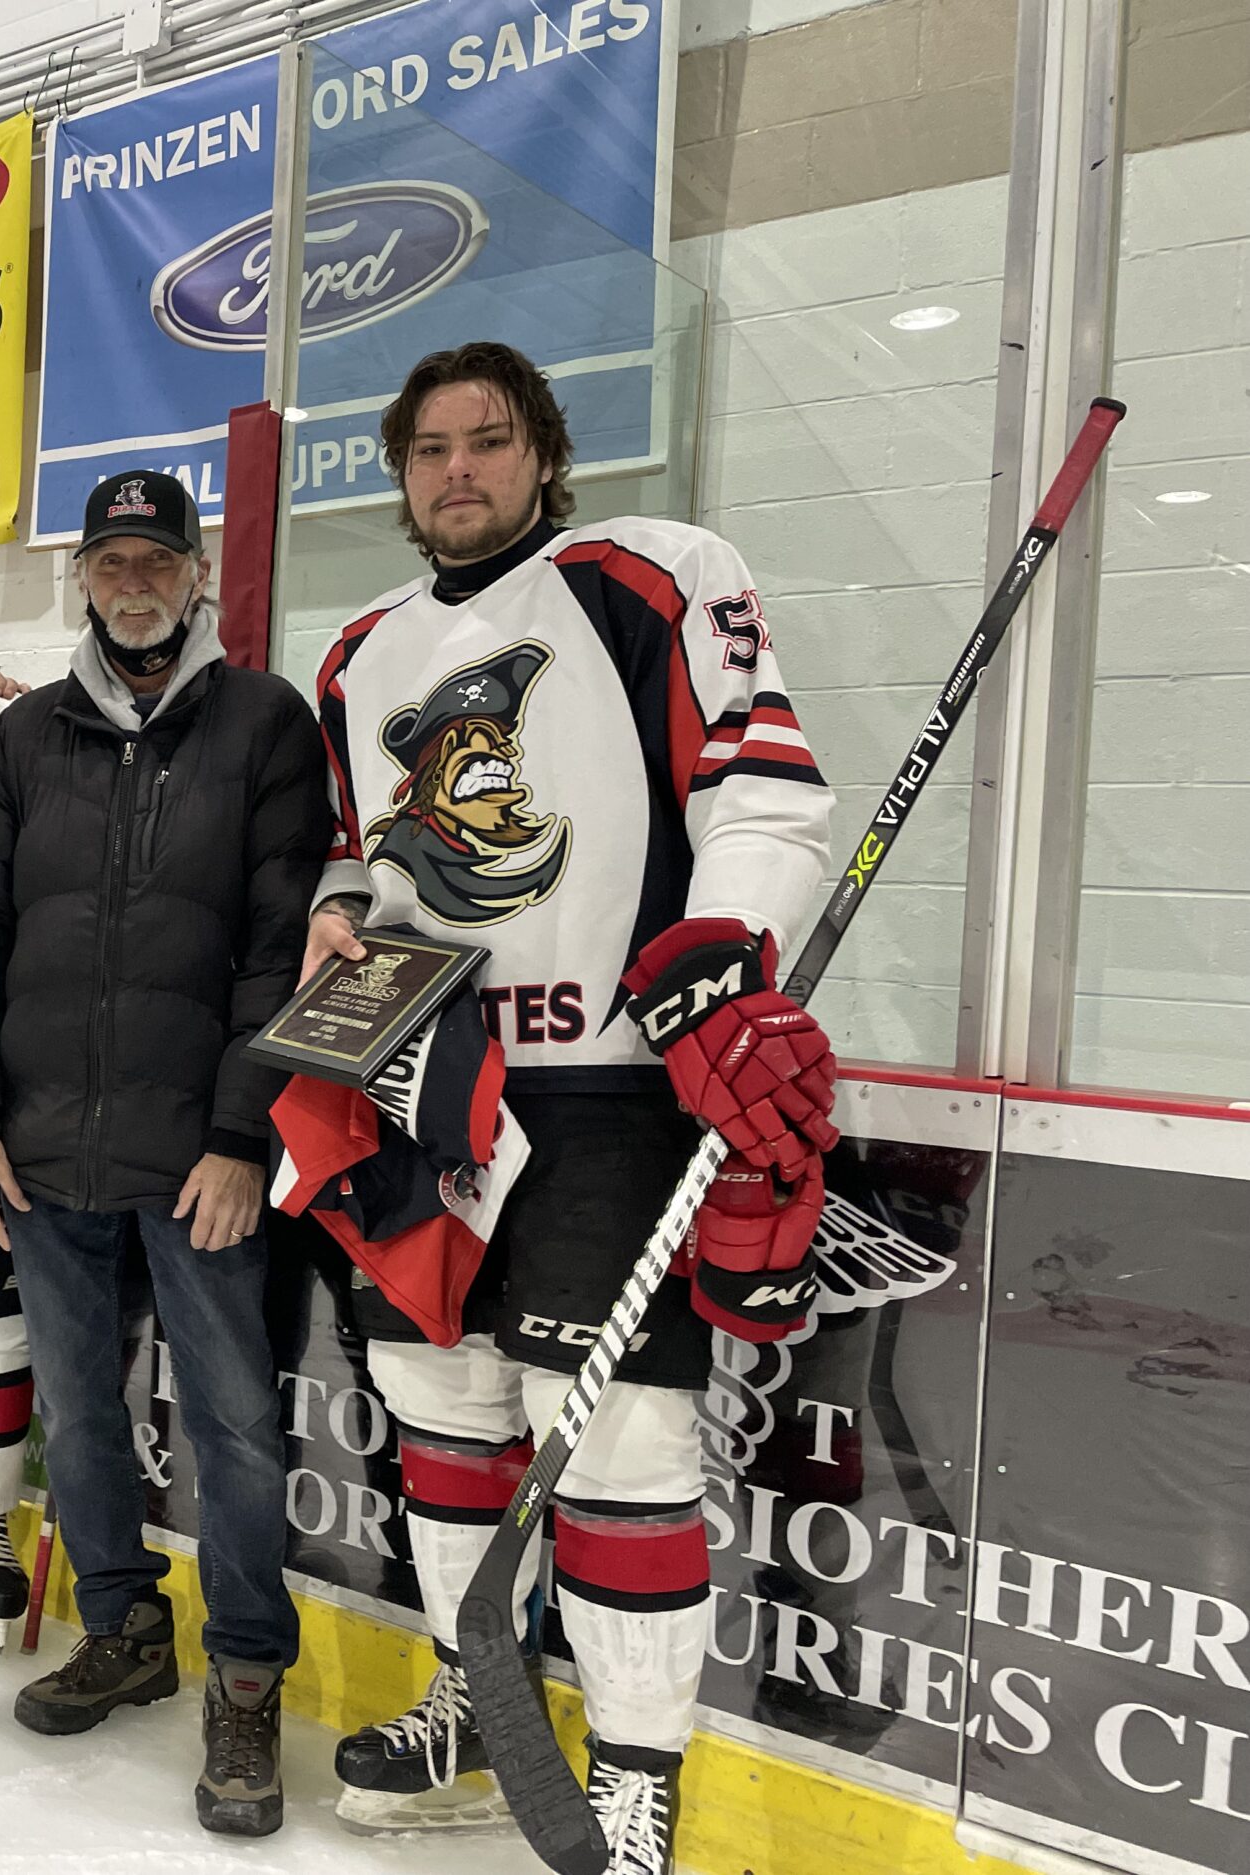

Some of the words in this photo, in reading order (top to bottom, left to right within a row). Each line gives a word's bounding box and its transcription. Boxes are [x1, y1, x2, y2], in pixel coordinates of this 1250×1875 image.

[61, 105, 261, 200] PRINZEN
[312, 55, 429, 130] ORD
[447, 0, 651, 90] SALES
[945, 631, 986, 704] WARRIOR
[875, 702, 950, 826] ALPHA
